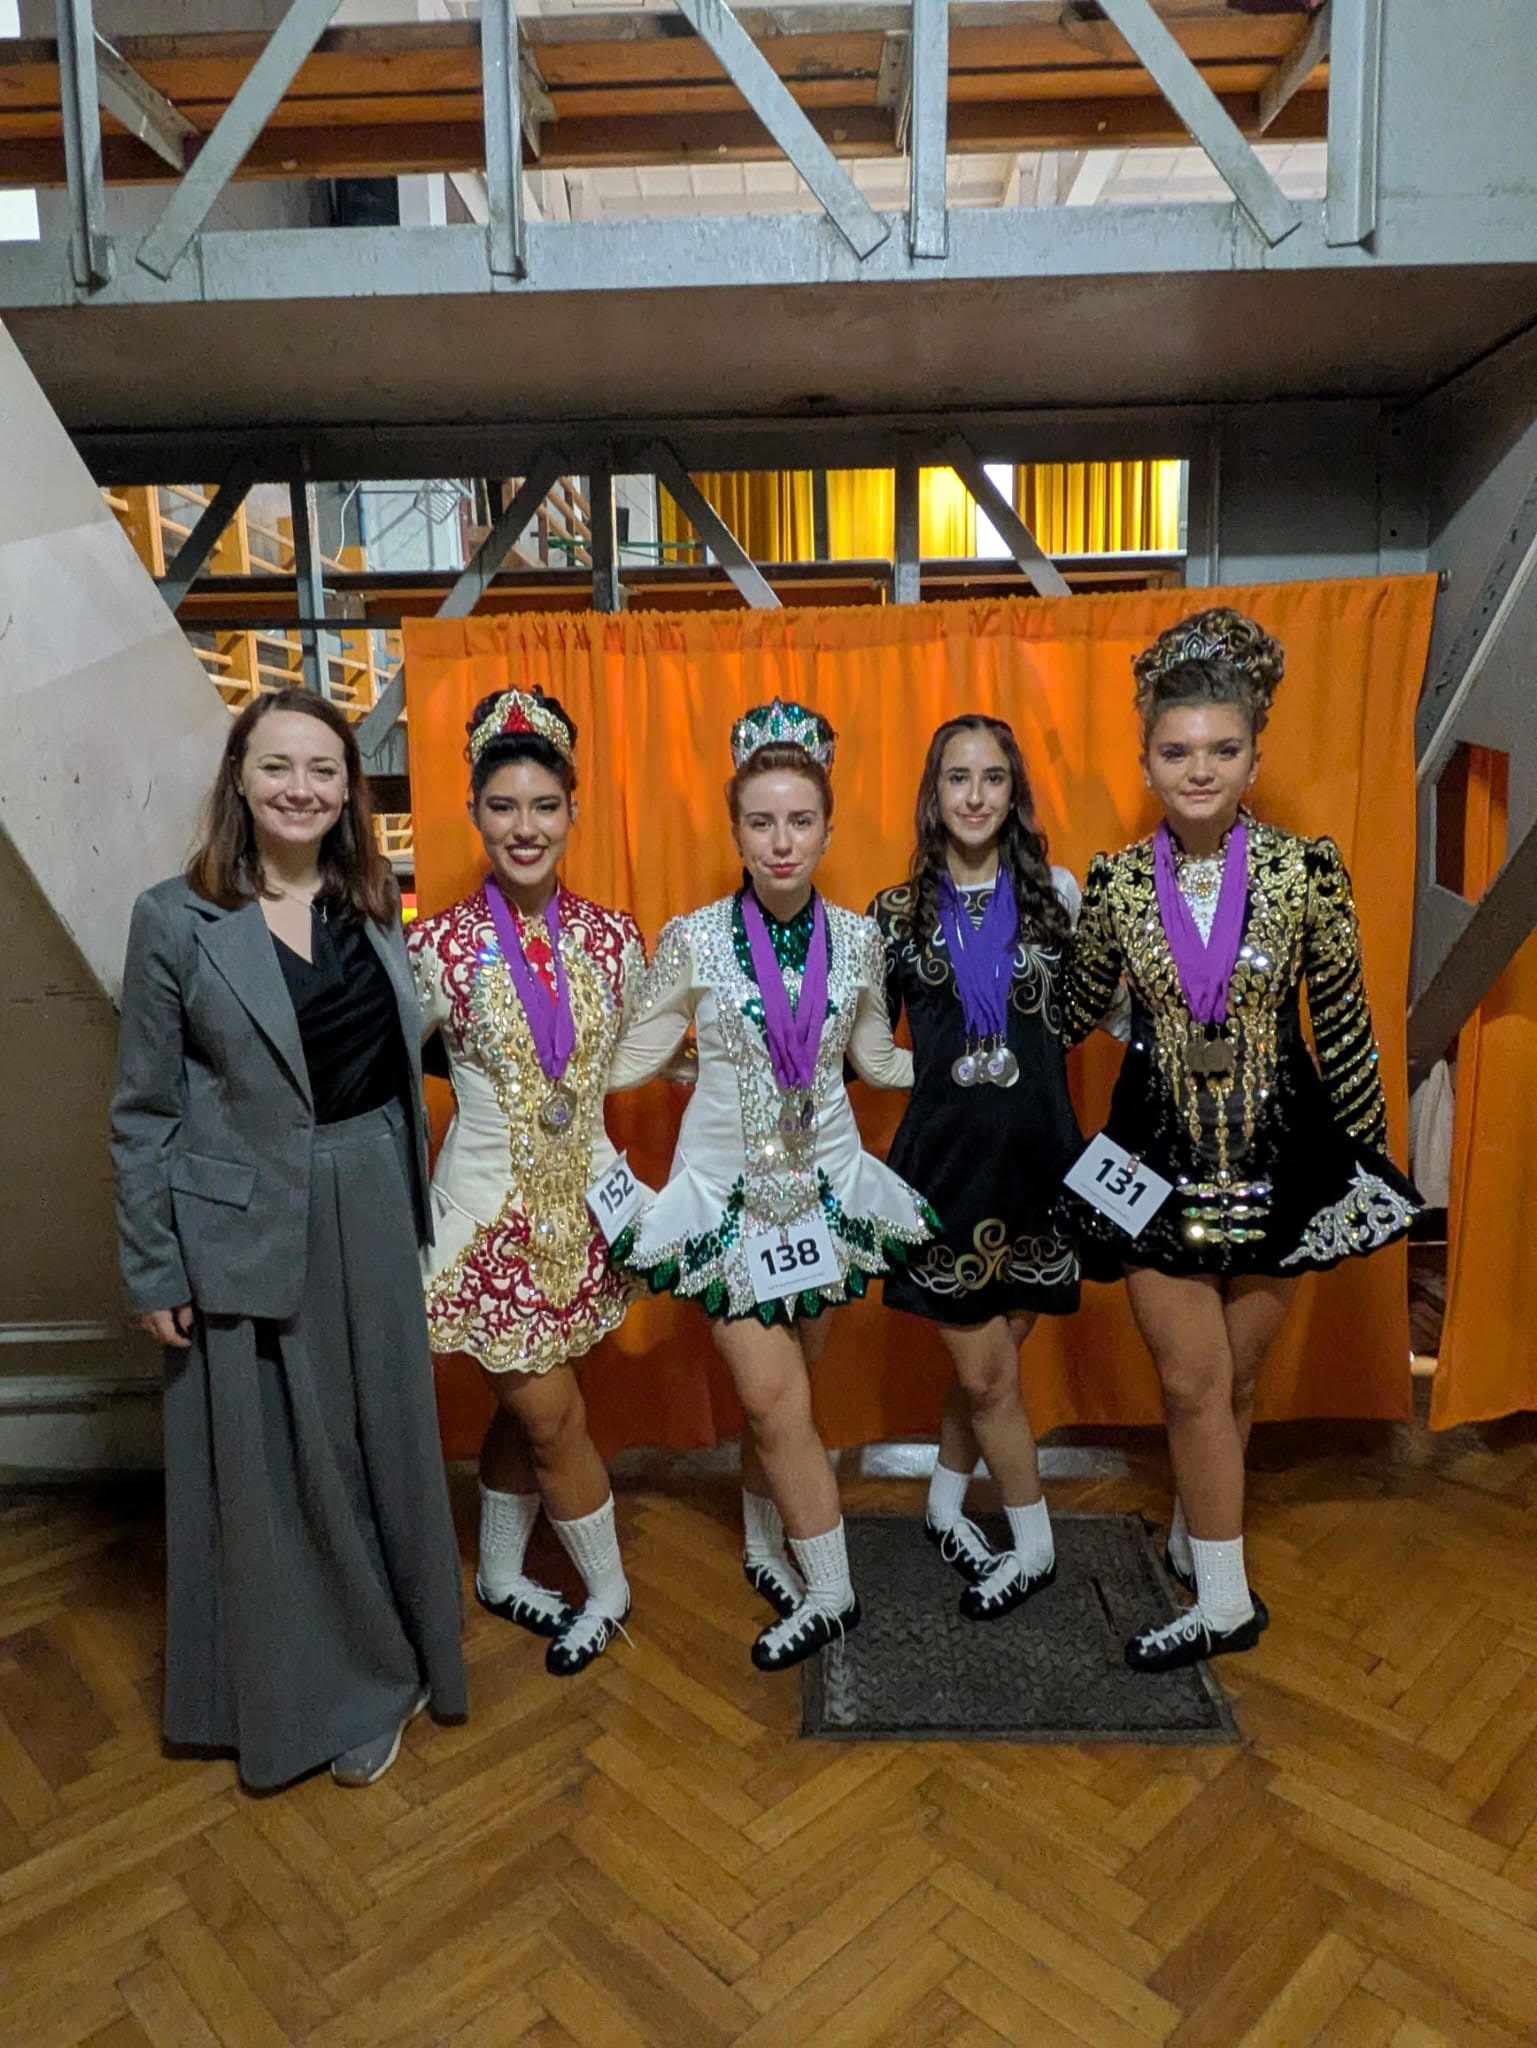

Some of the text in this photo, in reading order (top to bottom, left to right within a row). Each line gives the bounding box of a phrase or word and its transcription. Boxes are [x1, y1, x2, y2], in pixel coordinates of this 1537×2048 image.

[599, 1169, 635, 1214] 152
[1096, 1158, 1147, 1207] 131
[760, 1238, 820, 1276] 138
